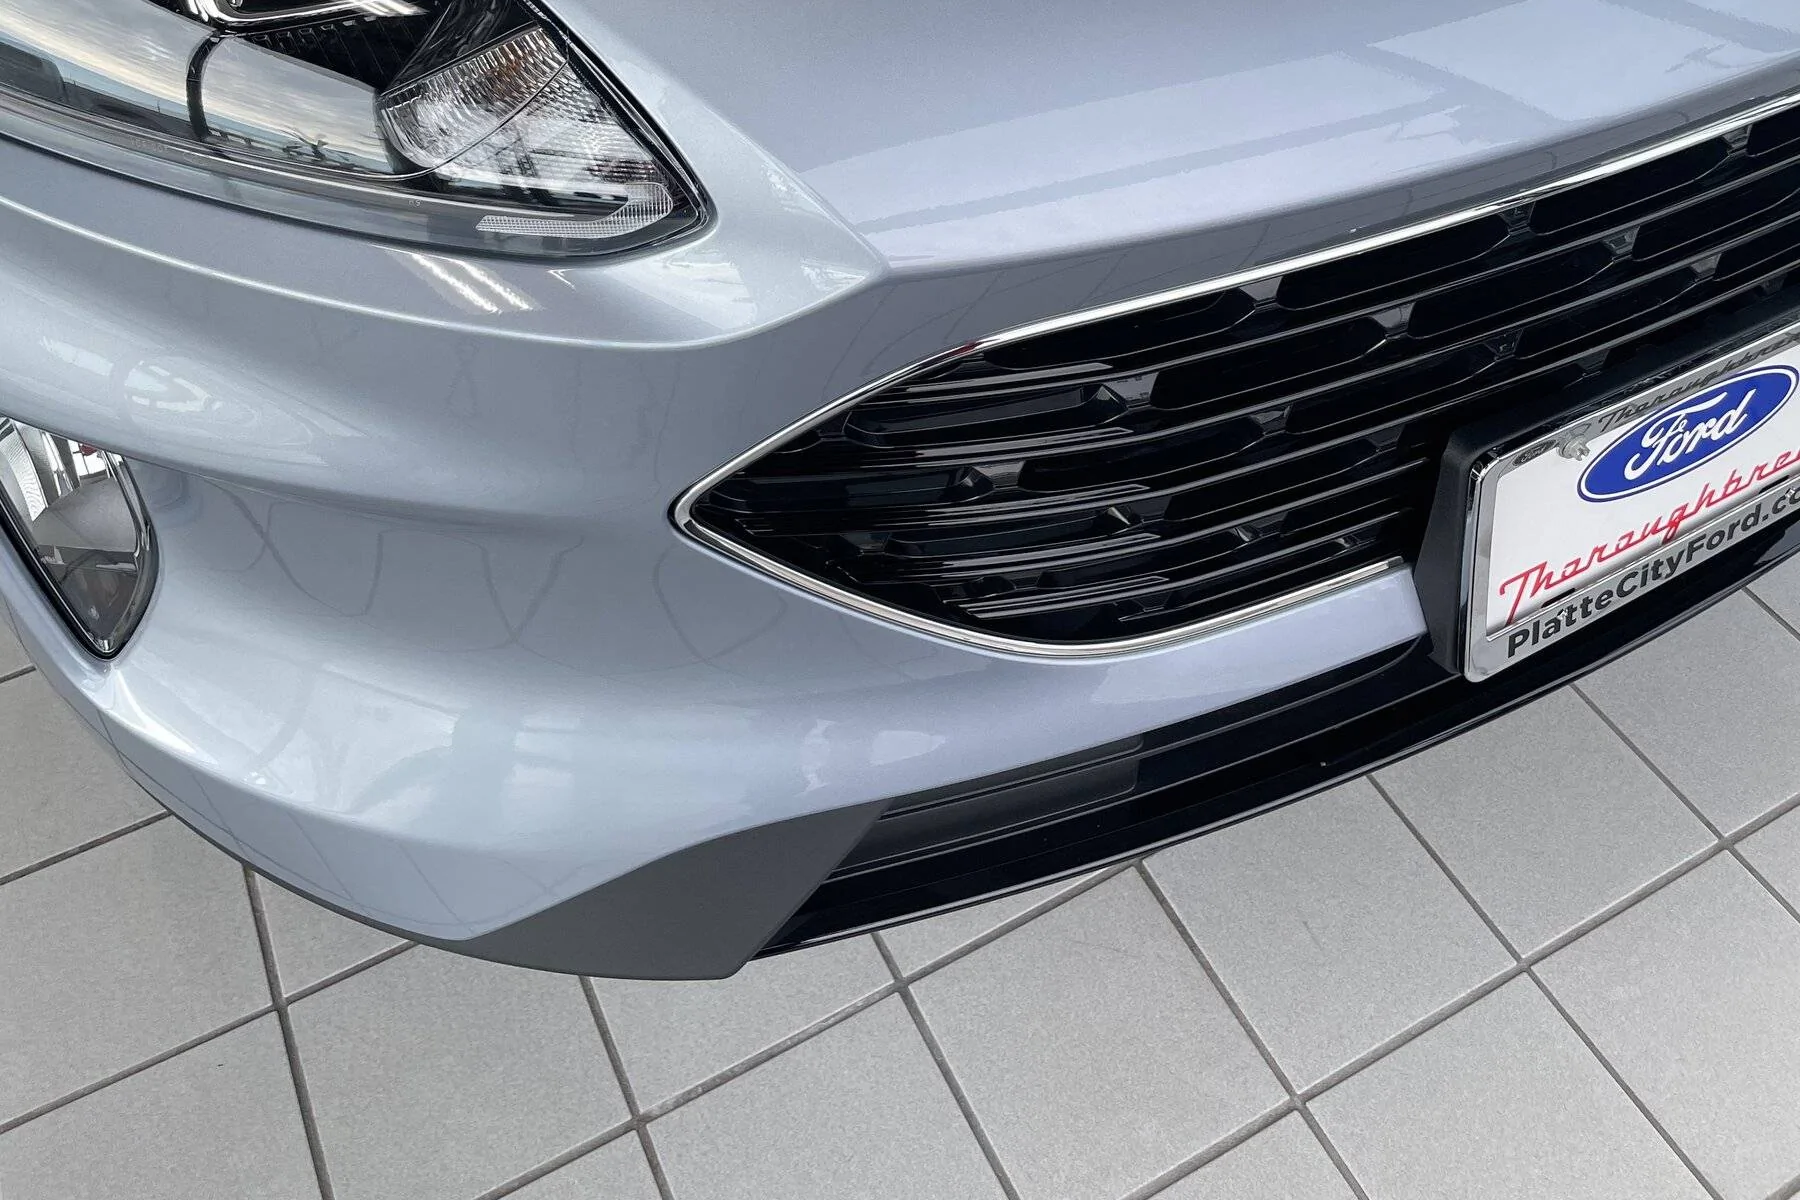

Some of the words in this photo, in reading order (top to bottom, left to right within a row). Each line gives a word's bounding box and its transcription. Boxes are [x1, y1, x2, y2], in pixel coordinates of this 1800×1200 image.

[1624, 388, 1757, 481] Ford
[1499, 448, 1800, 627] Thoroughbre
[1508, 486, 1800, 659] PlatteCityFord.co
